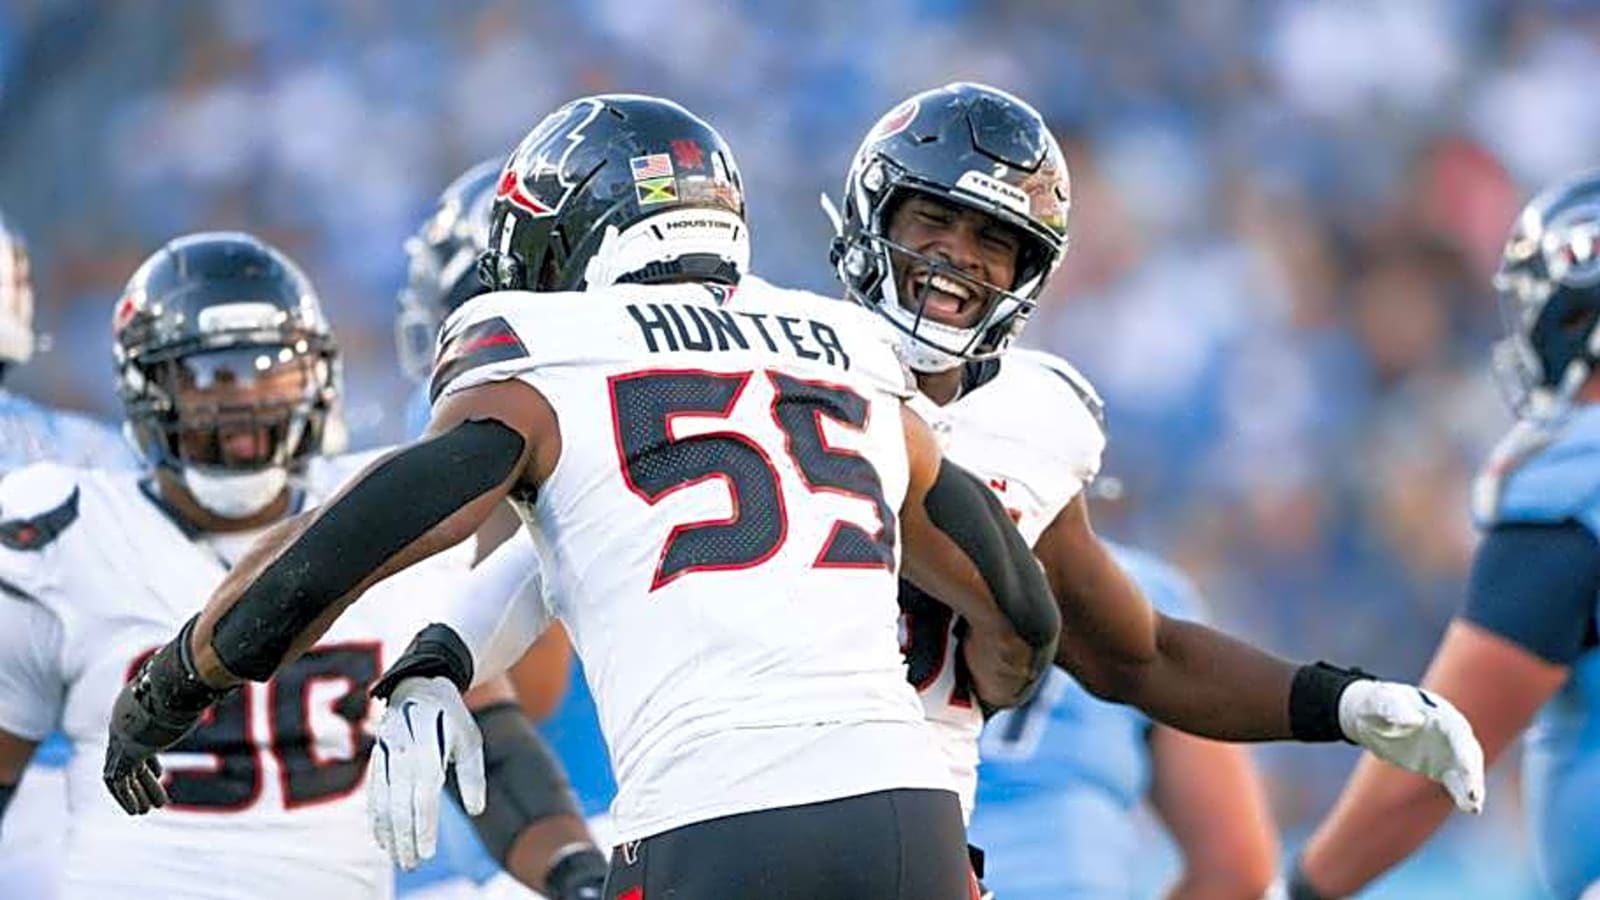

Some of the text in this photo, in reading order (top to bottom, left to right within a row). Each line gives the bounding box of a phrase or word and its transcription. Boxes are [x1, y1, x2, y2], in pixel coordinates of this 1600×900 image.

[666, 219, 732, 231] HOUSTON
[625, 303, 851, 372] HUNTER
[606, 366, 897, 593] 55
